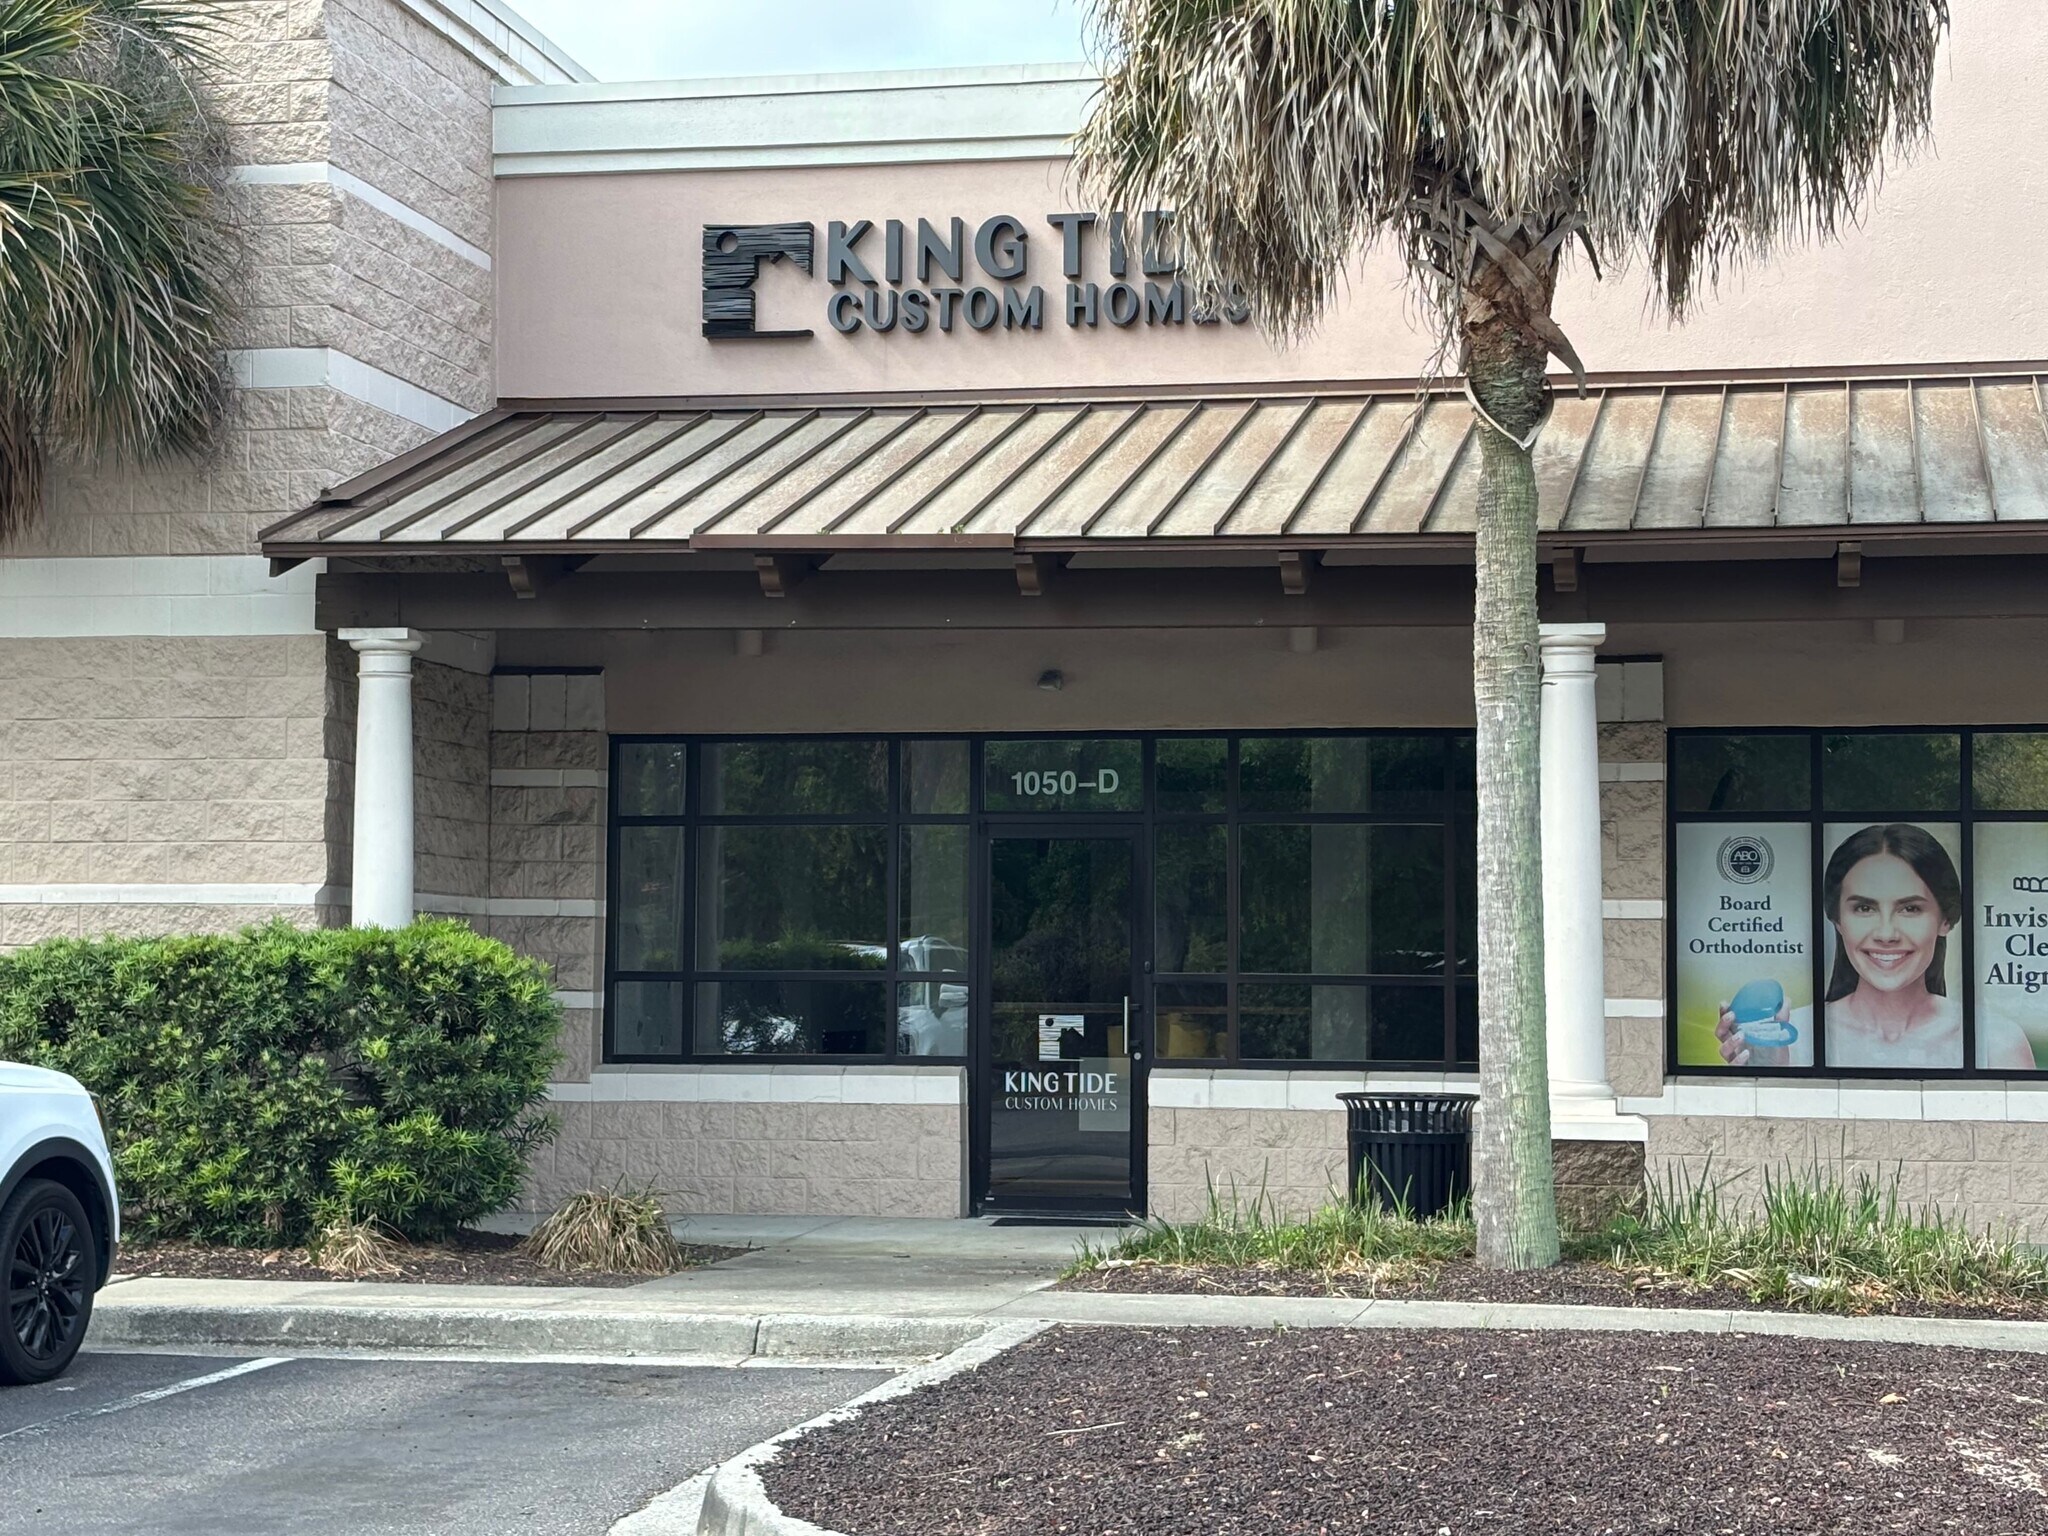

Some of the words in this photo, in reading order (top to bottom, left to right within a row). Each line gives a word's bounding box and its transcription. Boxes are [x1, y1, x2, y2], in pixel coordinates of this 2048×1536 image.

[827, 214, 1029, 286] KING
[1046, 211, 1234, 279] TID
[827, 286, 1044, 333] CUSTOM
[1011, 768, 1119, 796] 1050-D
[1733, 850, 1758, 862] ABO
[1719, 894, 1771, 911] Board
[1708, 916, 1784, 932] Certified
[1983, 905, 2048, 928] Invis
[1689, 938, 1804, 954] Orthodontist
[2005, 933, 2048, 957] Cle
[1005, 1071, 1059, 1093] KING
[1063, 1072, 1118, 1094] TIDE
[1005, 1096, 1063, 1110] CUSTOM
[1068, 1098, 1118, 1112] HOMES
